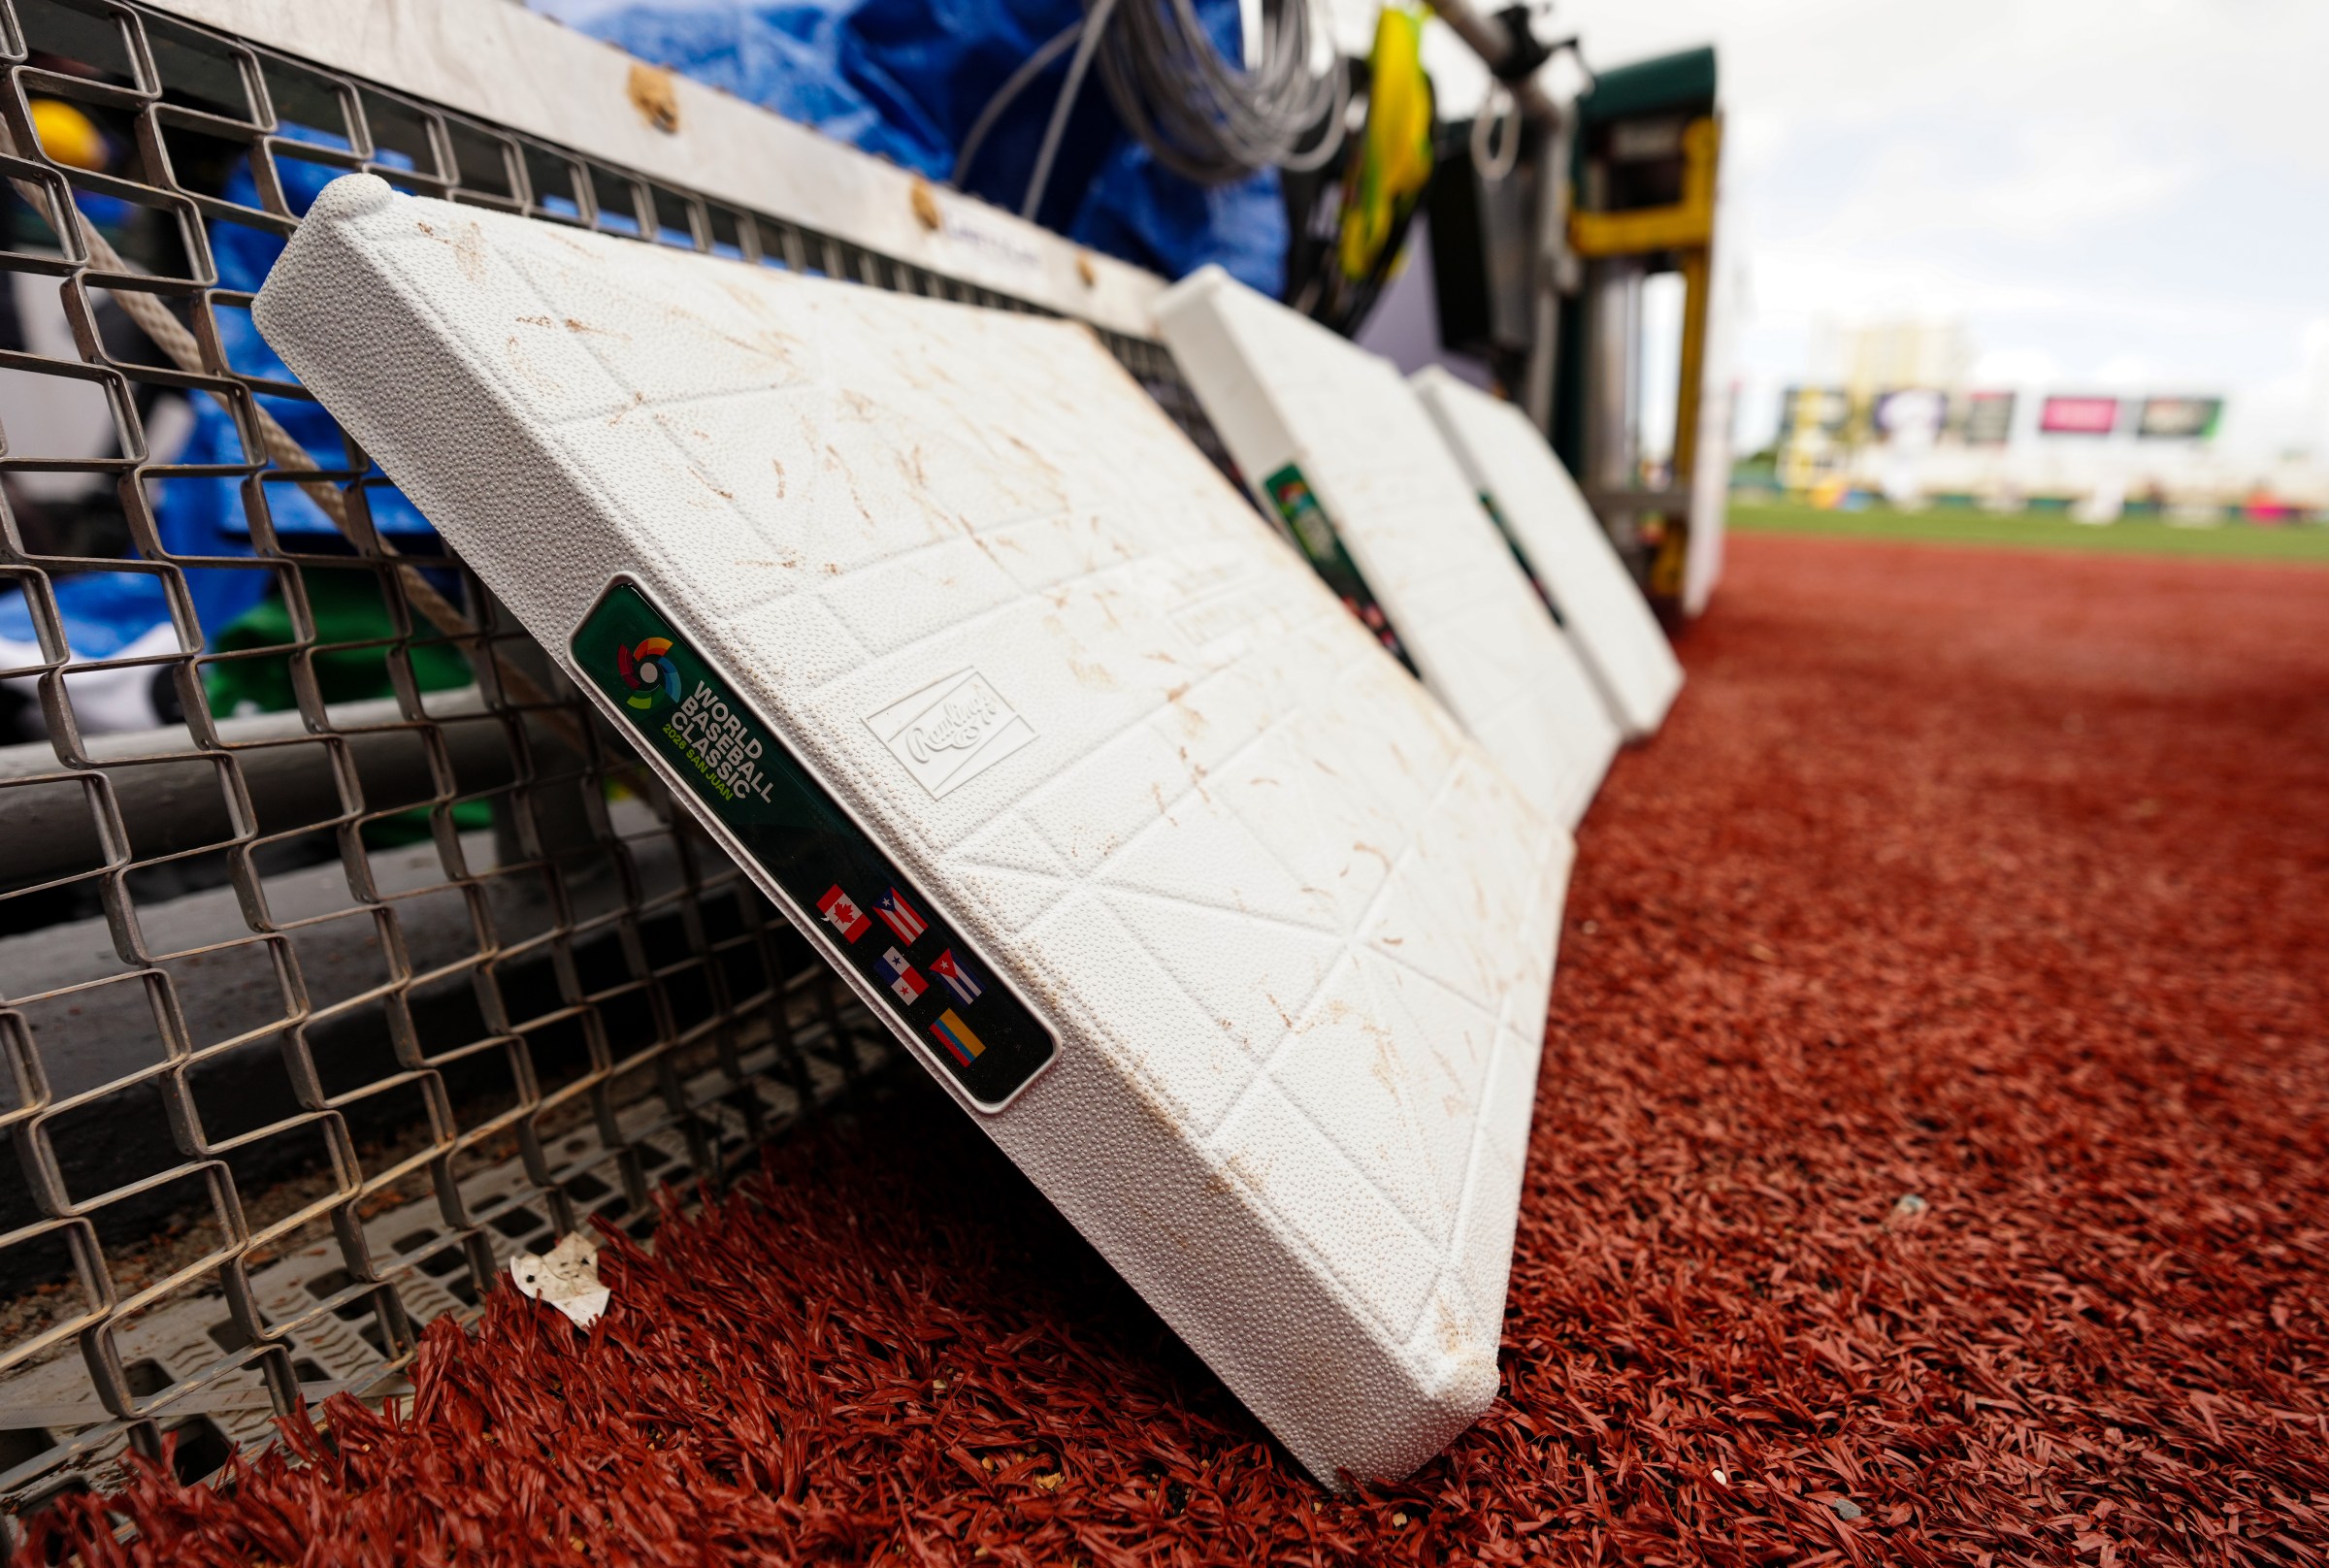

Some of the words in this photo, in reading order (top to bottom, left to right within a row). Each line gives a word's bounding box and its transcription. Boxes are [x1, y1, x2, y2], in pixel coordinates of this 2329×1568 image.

[662, 723, 686, 751] 2026
[685, 749, 708, 773] SAN
[705, 768, 734, 801] JUAN
[671, 711, 751, 800] CLASSIC
[680, 696, 774, 803] BASEBALL
[694, 680, 763, 760] WORLD
